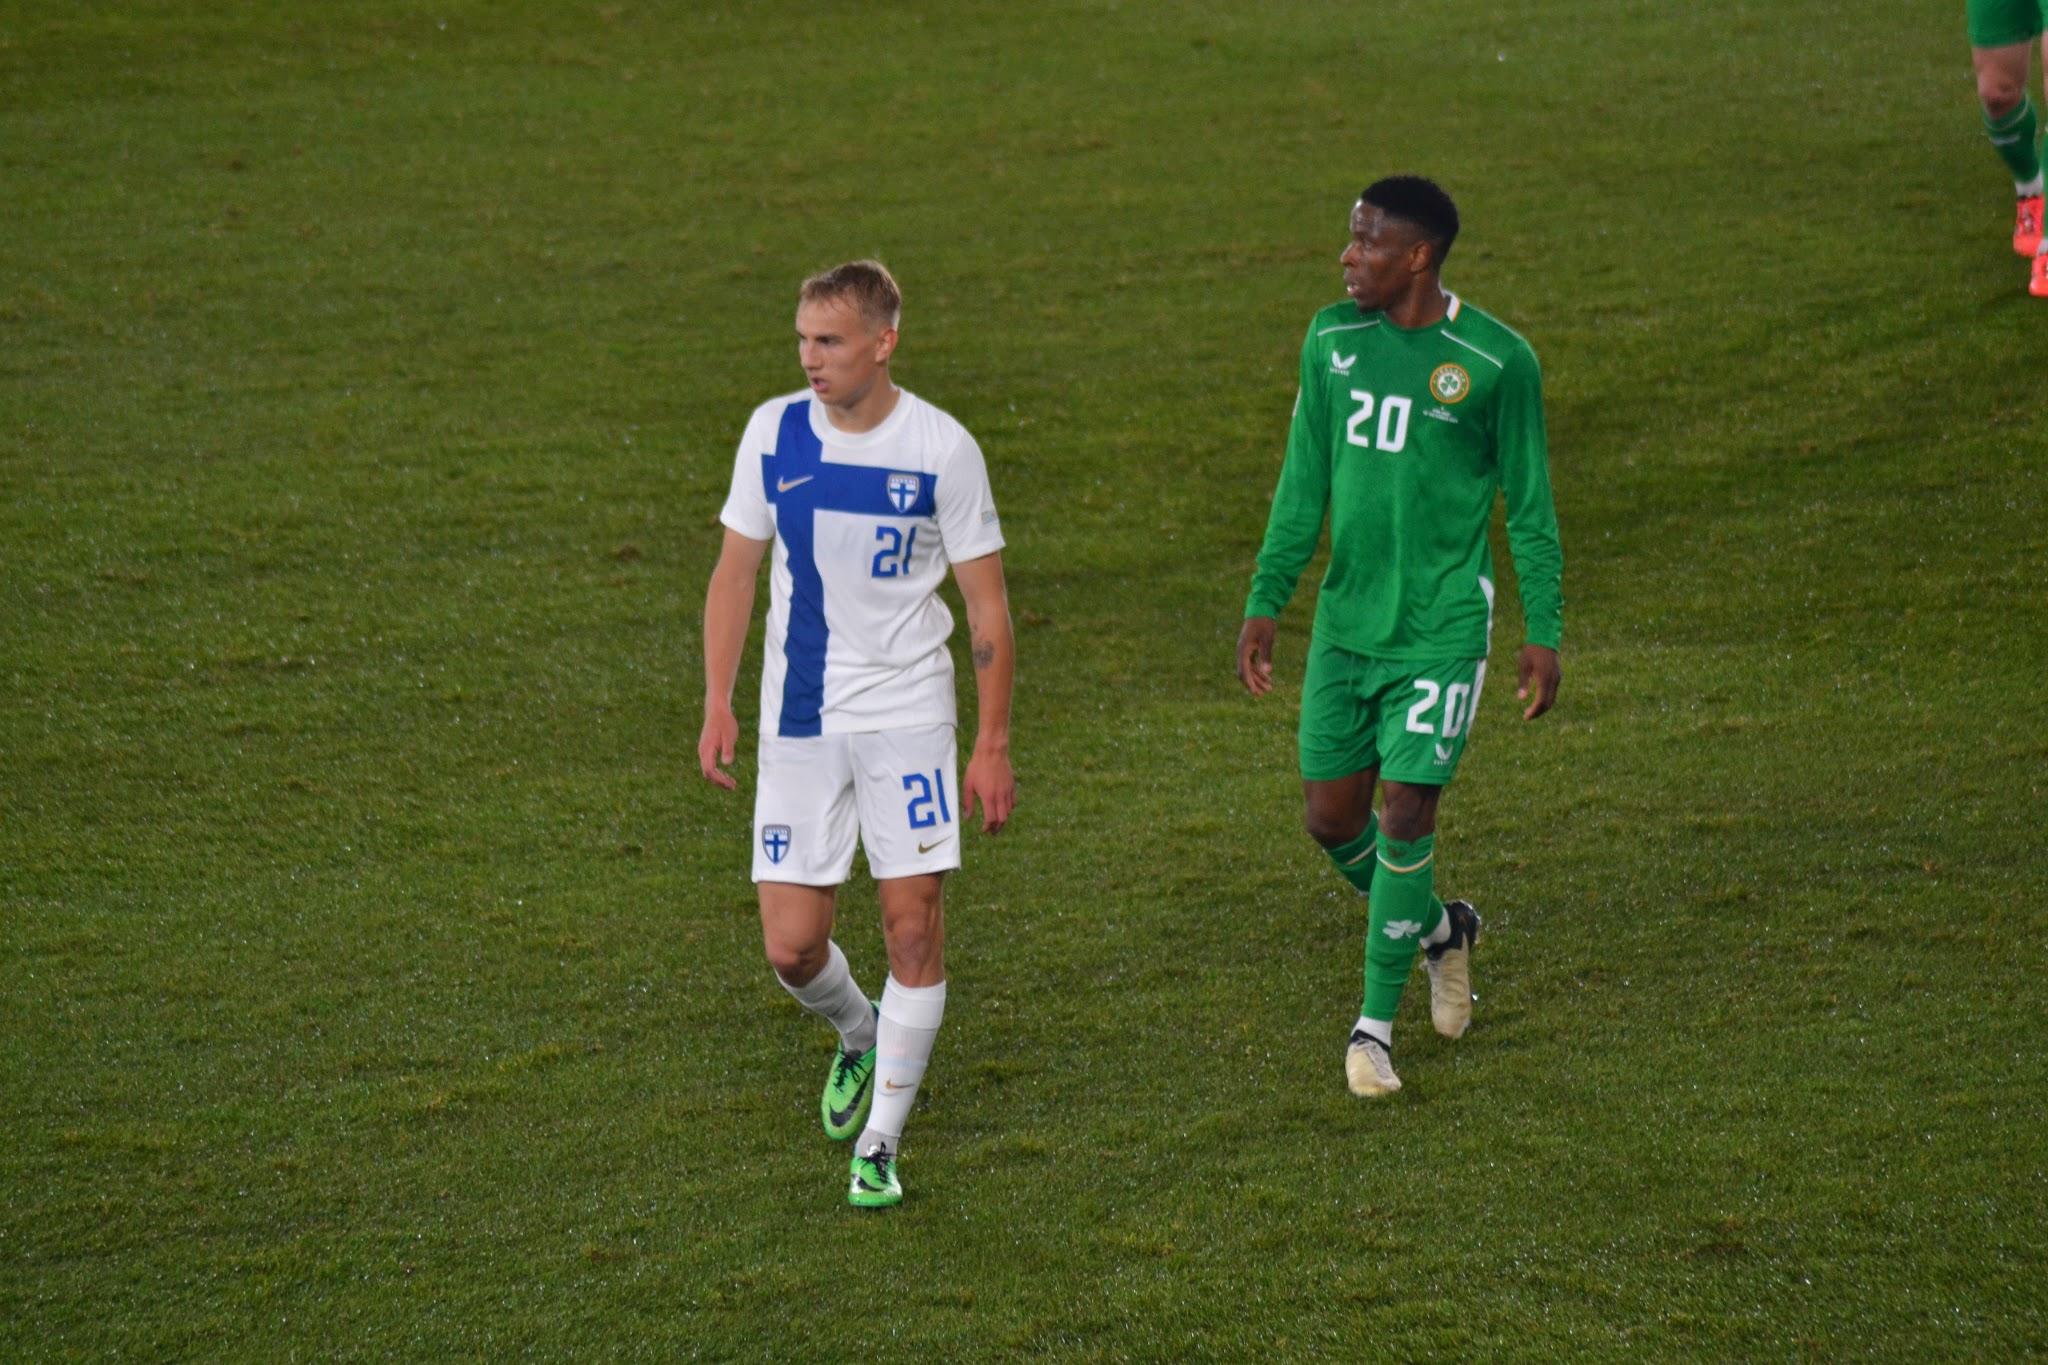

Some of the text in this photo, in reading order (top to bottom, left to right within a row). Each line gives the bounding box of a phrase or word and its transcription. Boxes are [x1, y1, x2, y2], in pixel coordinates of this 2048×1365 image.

[1346, 389, 1412, 453] 20
[871, 525, 917, 578] 21
[1405, 680, 1470, 738] 20
[902, 768, 951, 829] 21
